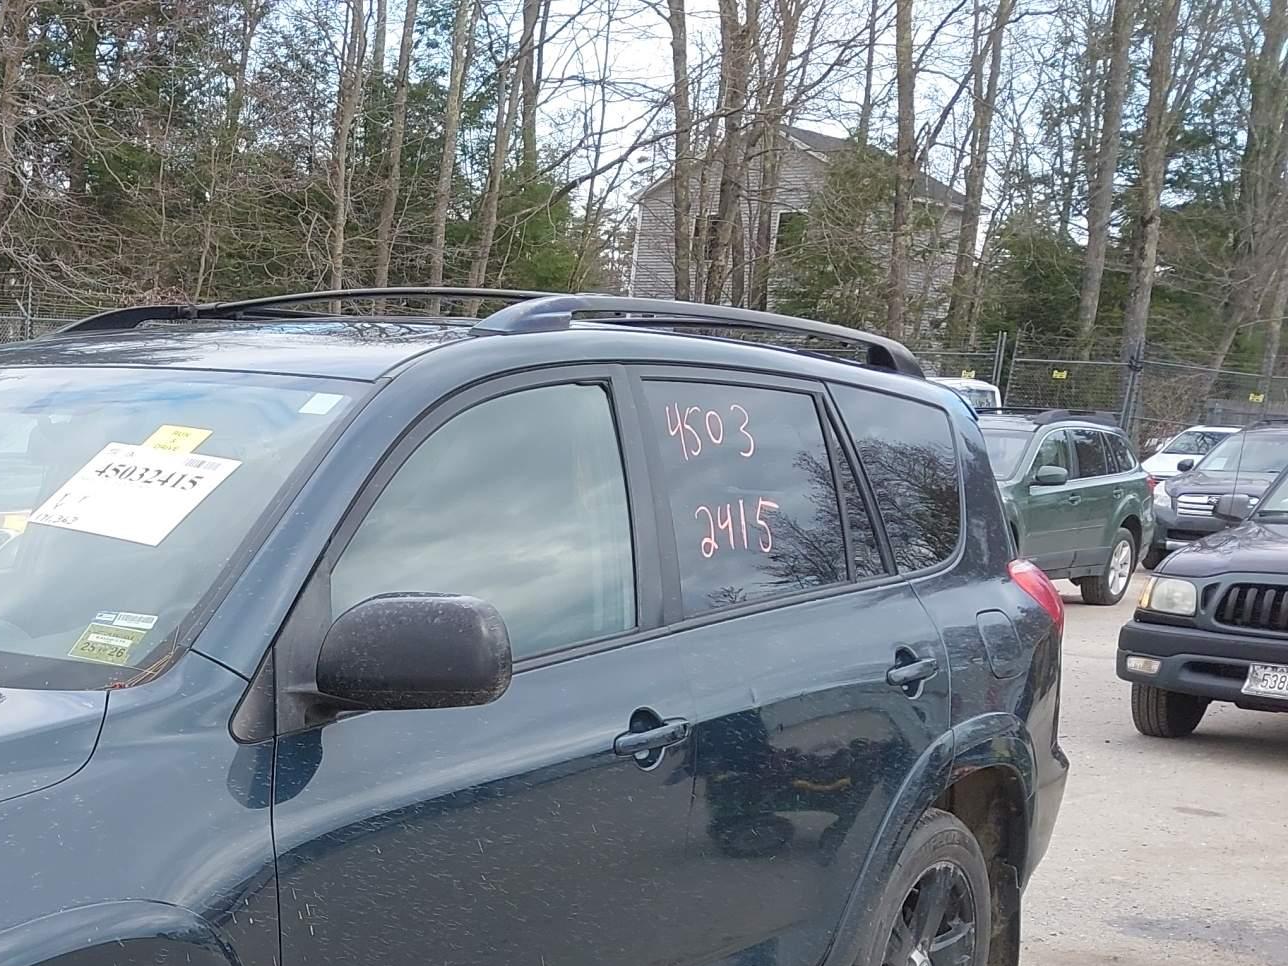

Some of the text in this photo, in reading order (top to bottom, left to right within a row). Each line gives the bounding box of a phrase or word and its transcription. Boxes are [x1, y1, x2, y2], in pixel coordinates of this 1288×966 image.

[666, 402, 755, 461] 4503
[95, 462, 204, 491] 45032415
[695, 497, 780, 558] 2415
[108, 646, 126, 658] 26
